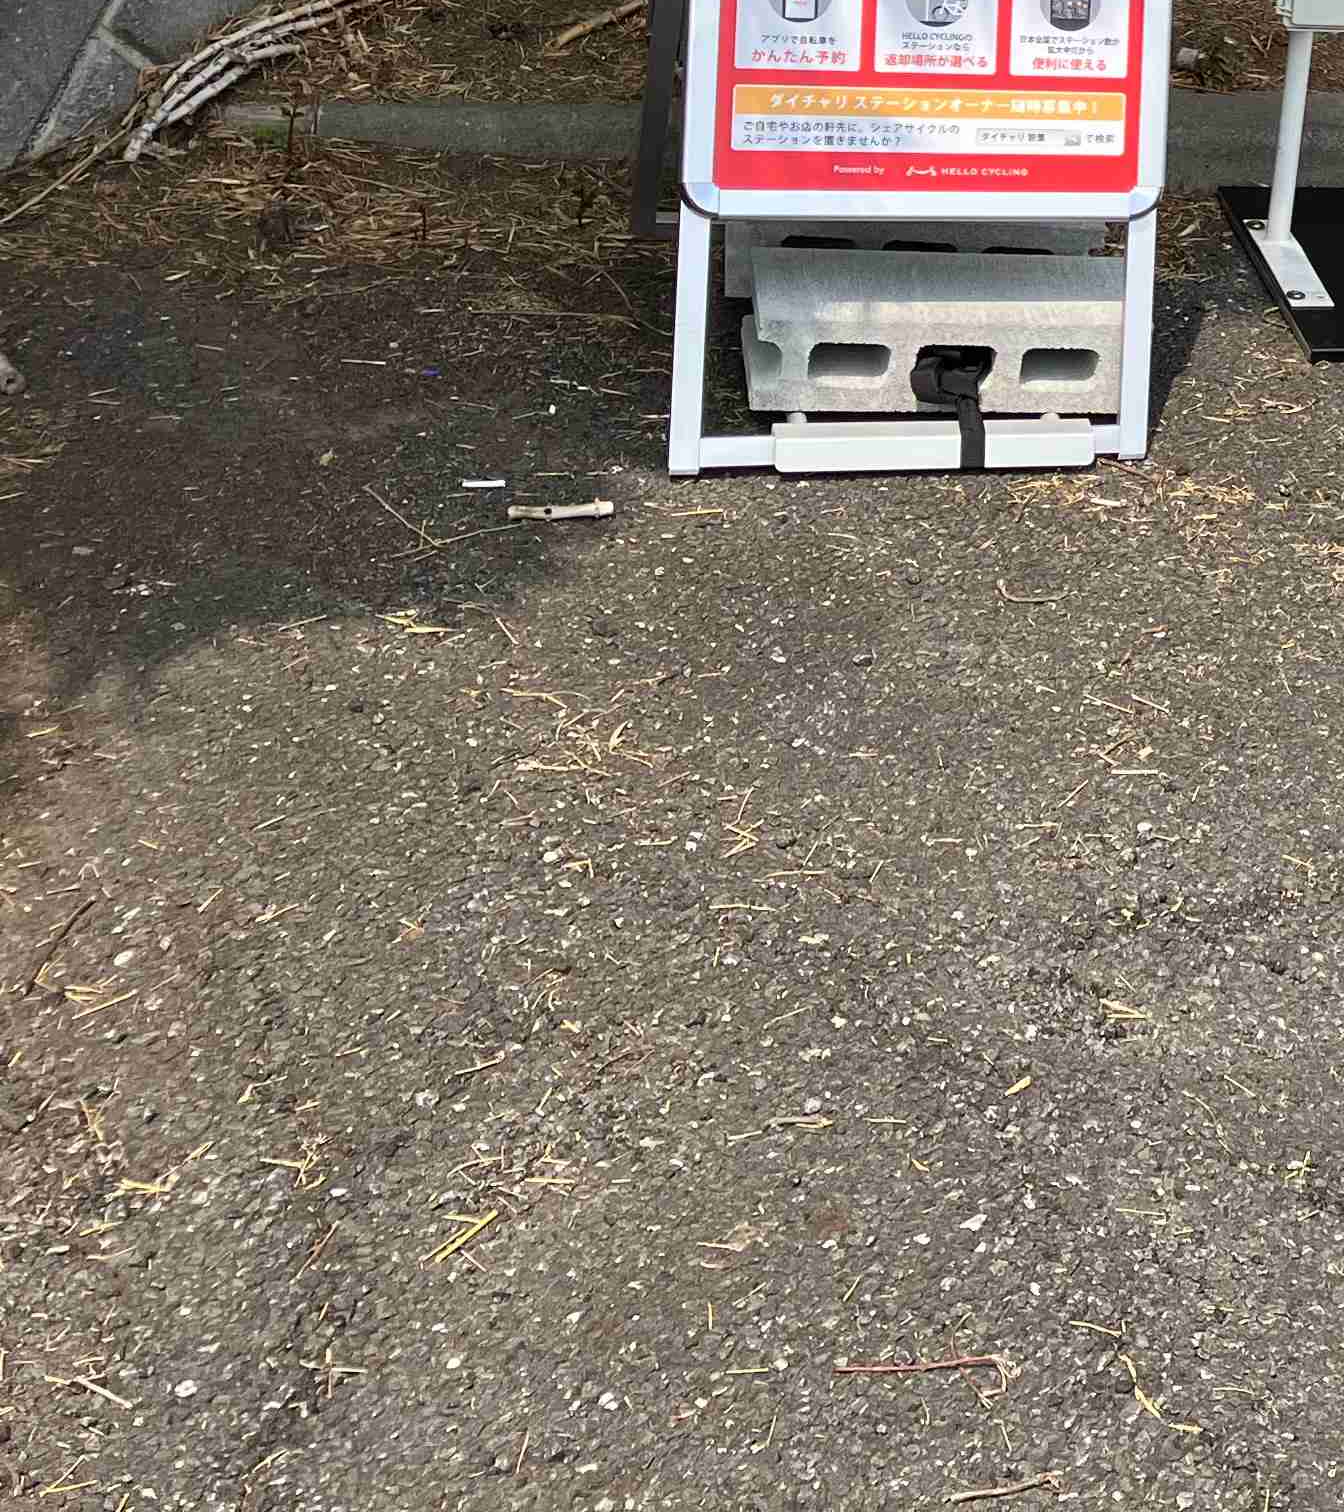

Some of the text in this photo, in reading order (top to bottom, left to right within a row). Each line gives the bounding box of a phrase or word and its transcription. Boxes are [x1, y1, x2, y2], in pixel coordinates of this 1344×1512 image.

[751, 48, 848, 65] かんたん予約
[769, 93, 848, 109] ダイチャリ
[833, 164, 885, 176] Powered by
[940, 167, 1029, 177] HELLO CYCLING
